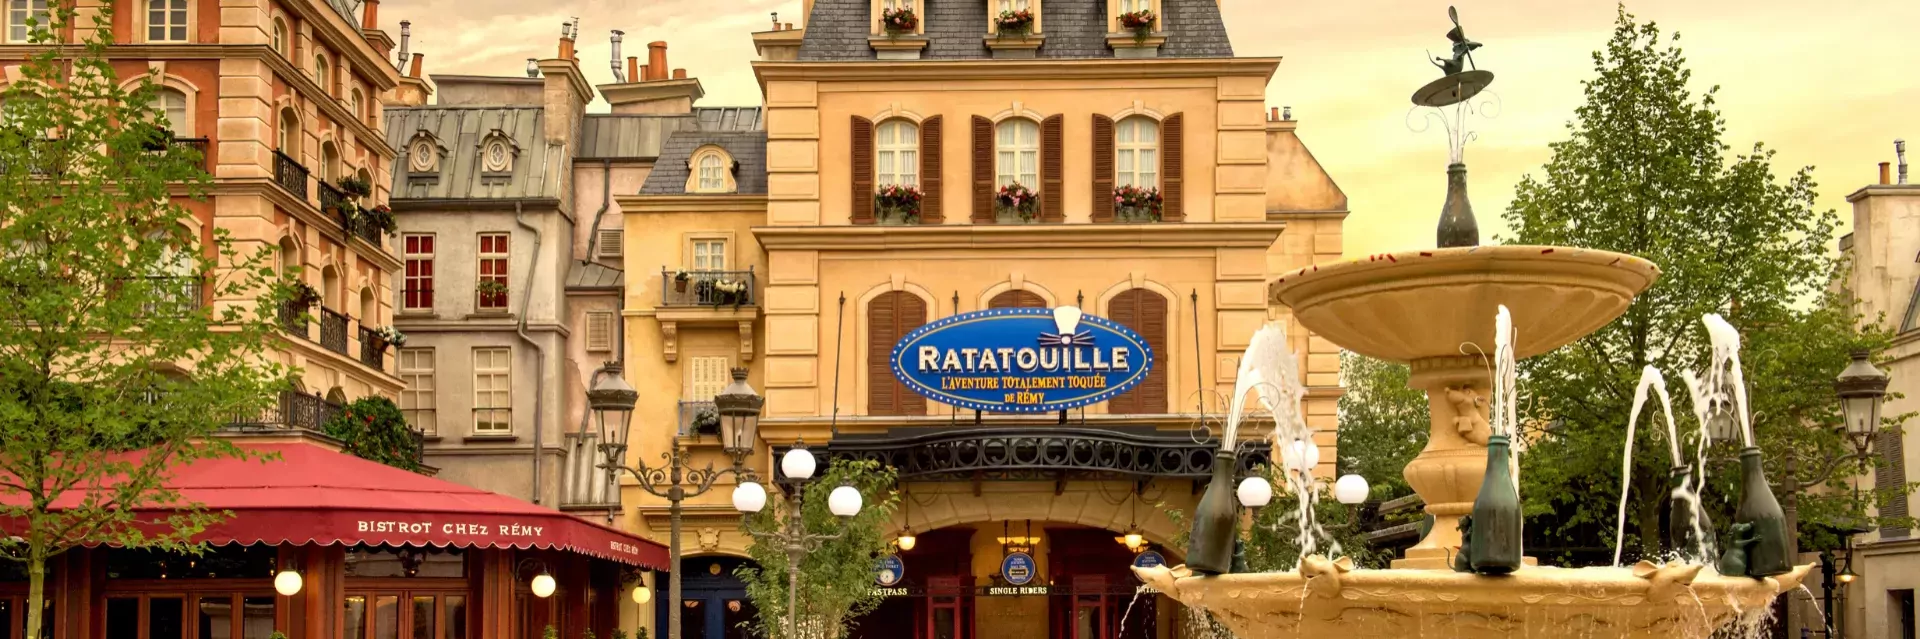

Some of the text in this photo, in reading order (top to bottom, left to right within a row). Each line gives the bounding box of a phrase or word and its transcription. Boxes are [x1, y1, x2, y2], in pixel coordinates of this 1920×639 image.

[918, 345, 1130, 373] RATATOUILLE
[942, 372, 1106, 390] L'AVENTURE TOTALEMENT TOQUÉE
[1004, 389, 1045, 404] DE RÉMY
[357, 520, 543, 537] BISTROT CHEZ RÉMY
[867, 587, 908, 596] FASTPASS
[989, 587, 1048, 595] SINGLE RIDERS
